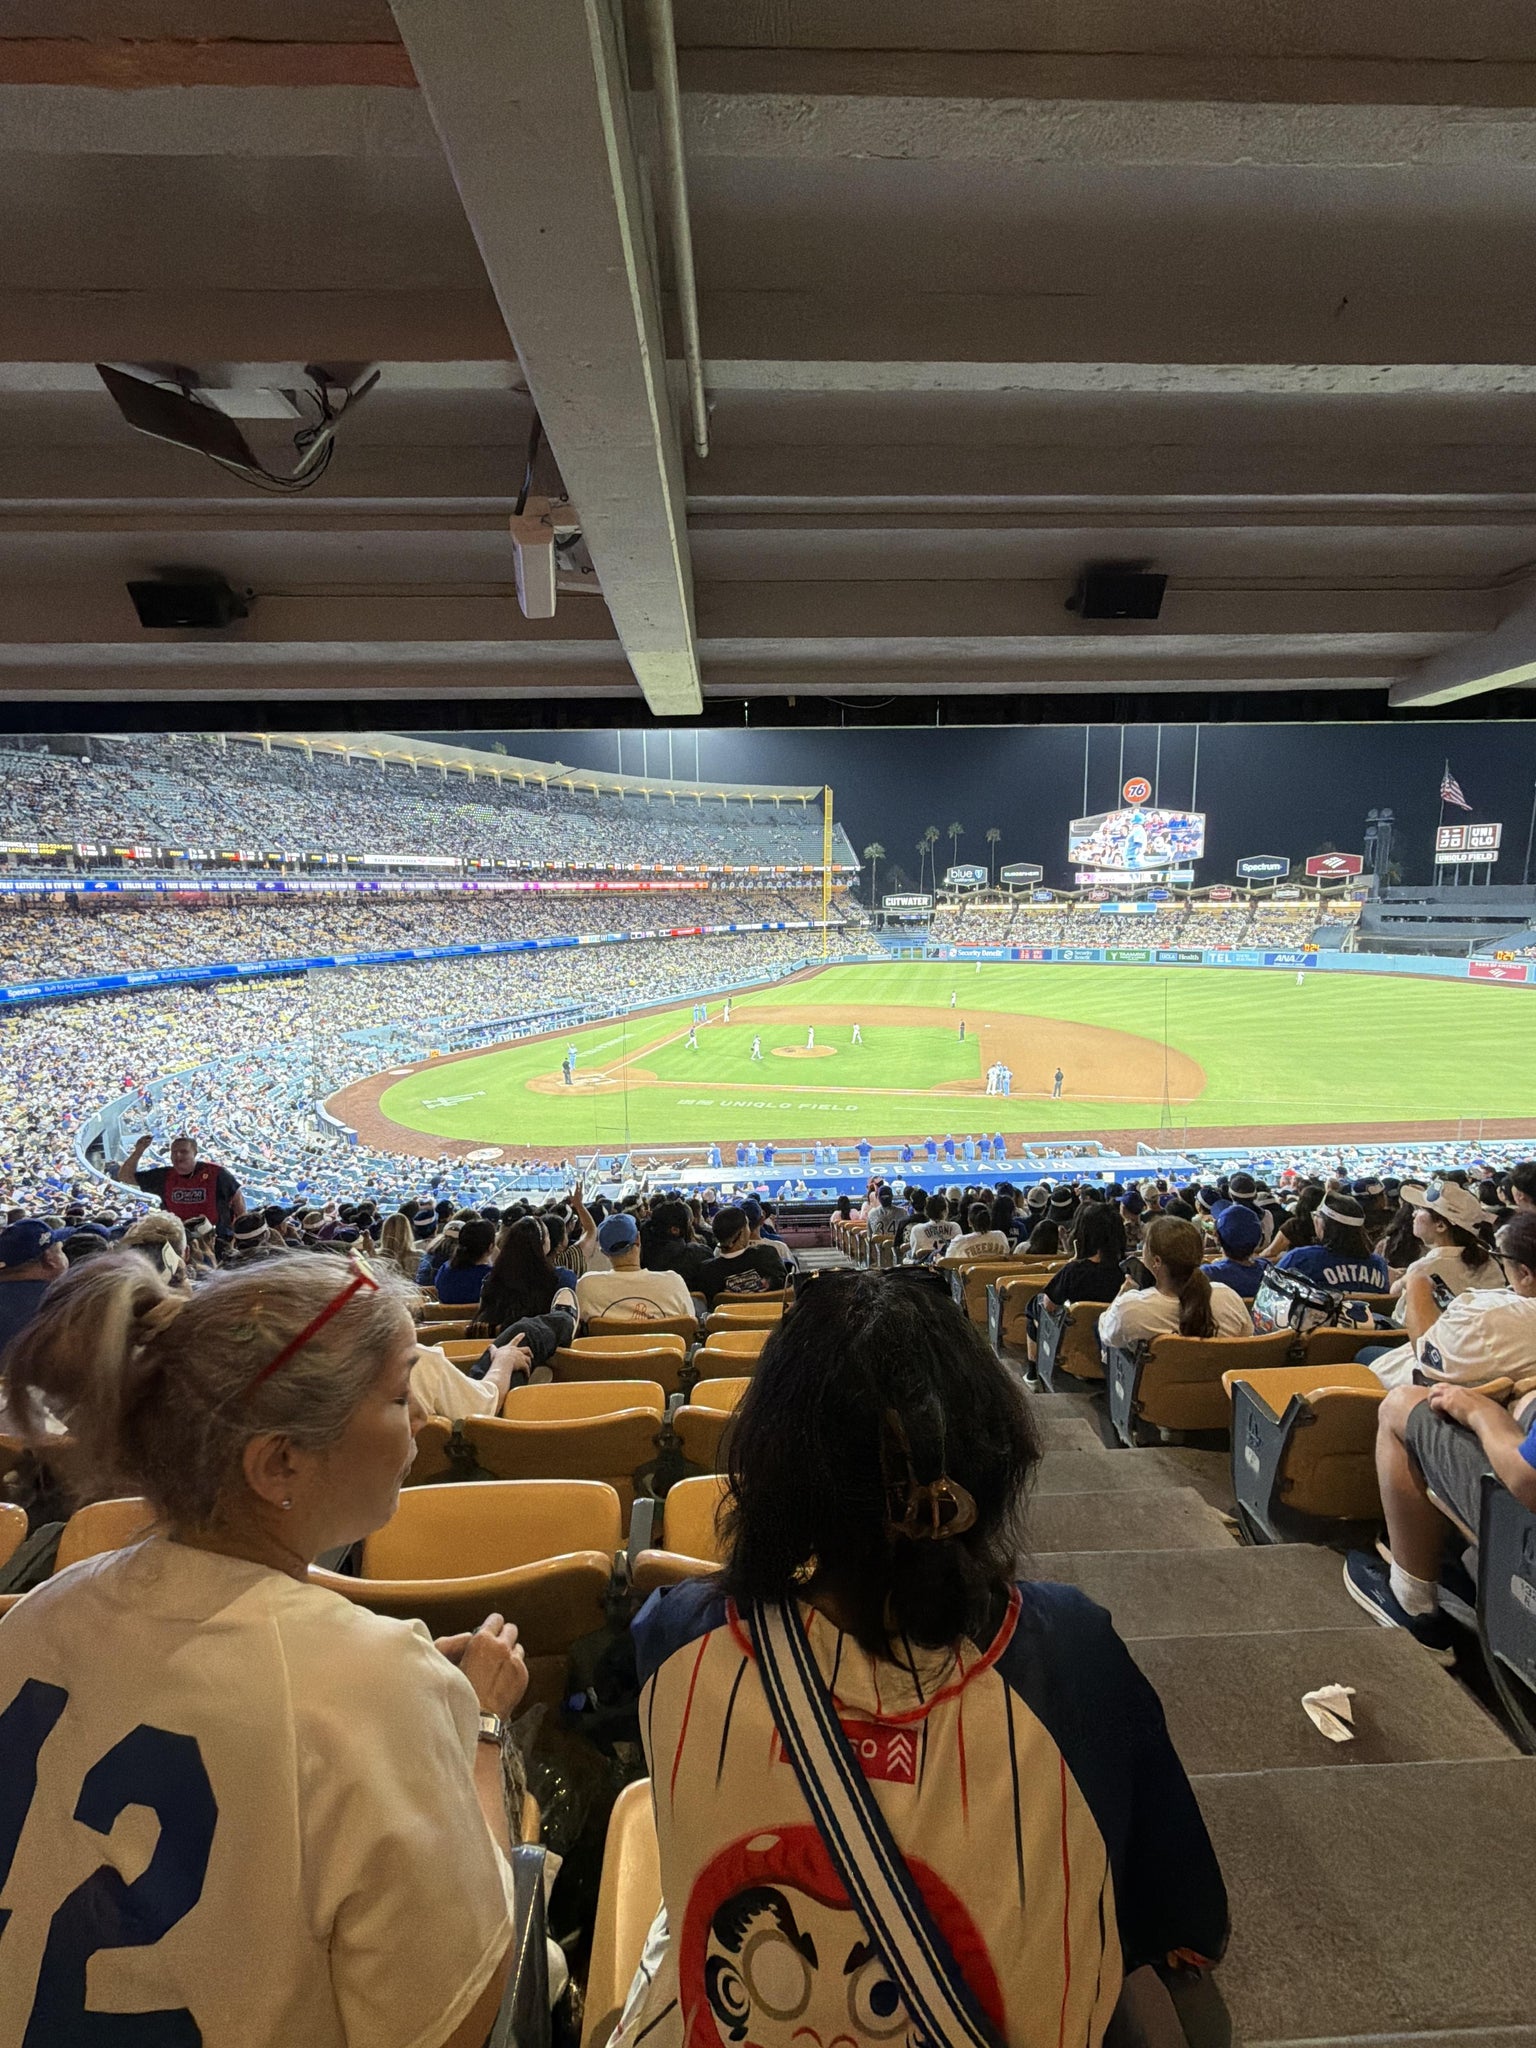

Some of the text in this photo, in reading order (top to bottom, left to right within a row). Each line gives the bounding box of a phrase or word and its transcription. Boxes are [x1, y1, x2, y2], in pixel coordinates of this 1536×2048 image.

[1129, 784, 1145, 797] 76
[1472, 827, 1493, 836] UNI
[1471, 837, 1494, 847] QLO
[1438, 852, 1493, 862] UNIQLO FIELD
[1242, 863, 1281, 873] Spectrum
[951, 869, 973, 879] blue
[885, 897, 929, 906] CUTWATER
[958, 950, 981, 958] Security
[1178, 953, 1199, 961] Health
[1210, 953, 1232, 963] TEL
[1274, 954, 1296, 962] ANA
[127, 974, 159, 984] Spectrum
[7, 987, 41, 998] Spectrum
[44, 985, 56, 993] Built
[719, 1100, 793, 1109] UNIQLO
[798, 1103, 859, 1111] FIELD
[802, 1161, 1073, 1177] DODGER STADIUM
[876, 1219, 896, 1234] 34
[1323, 1264, 1386, 1289] OHTANI
